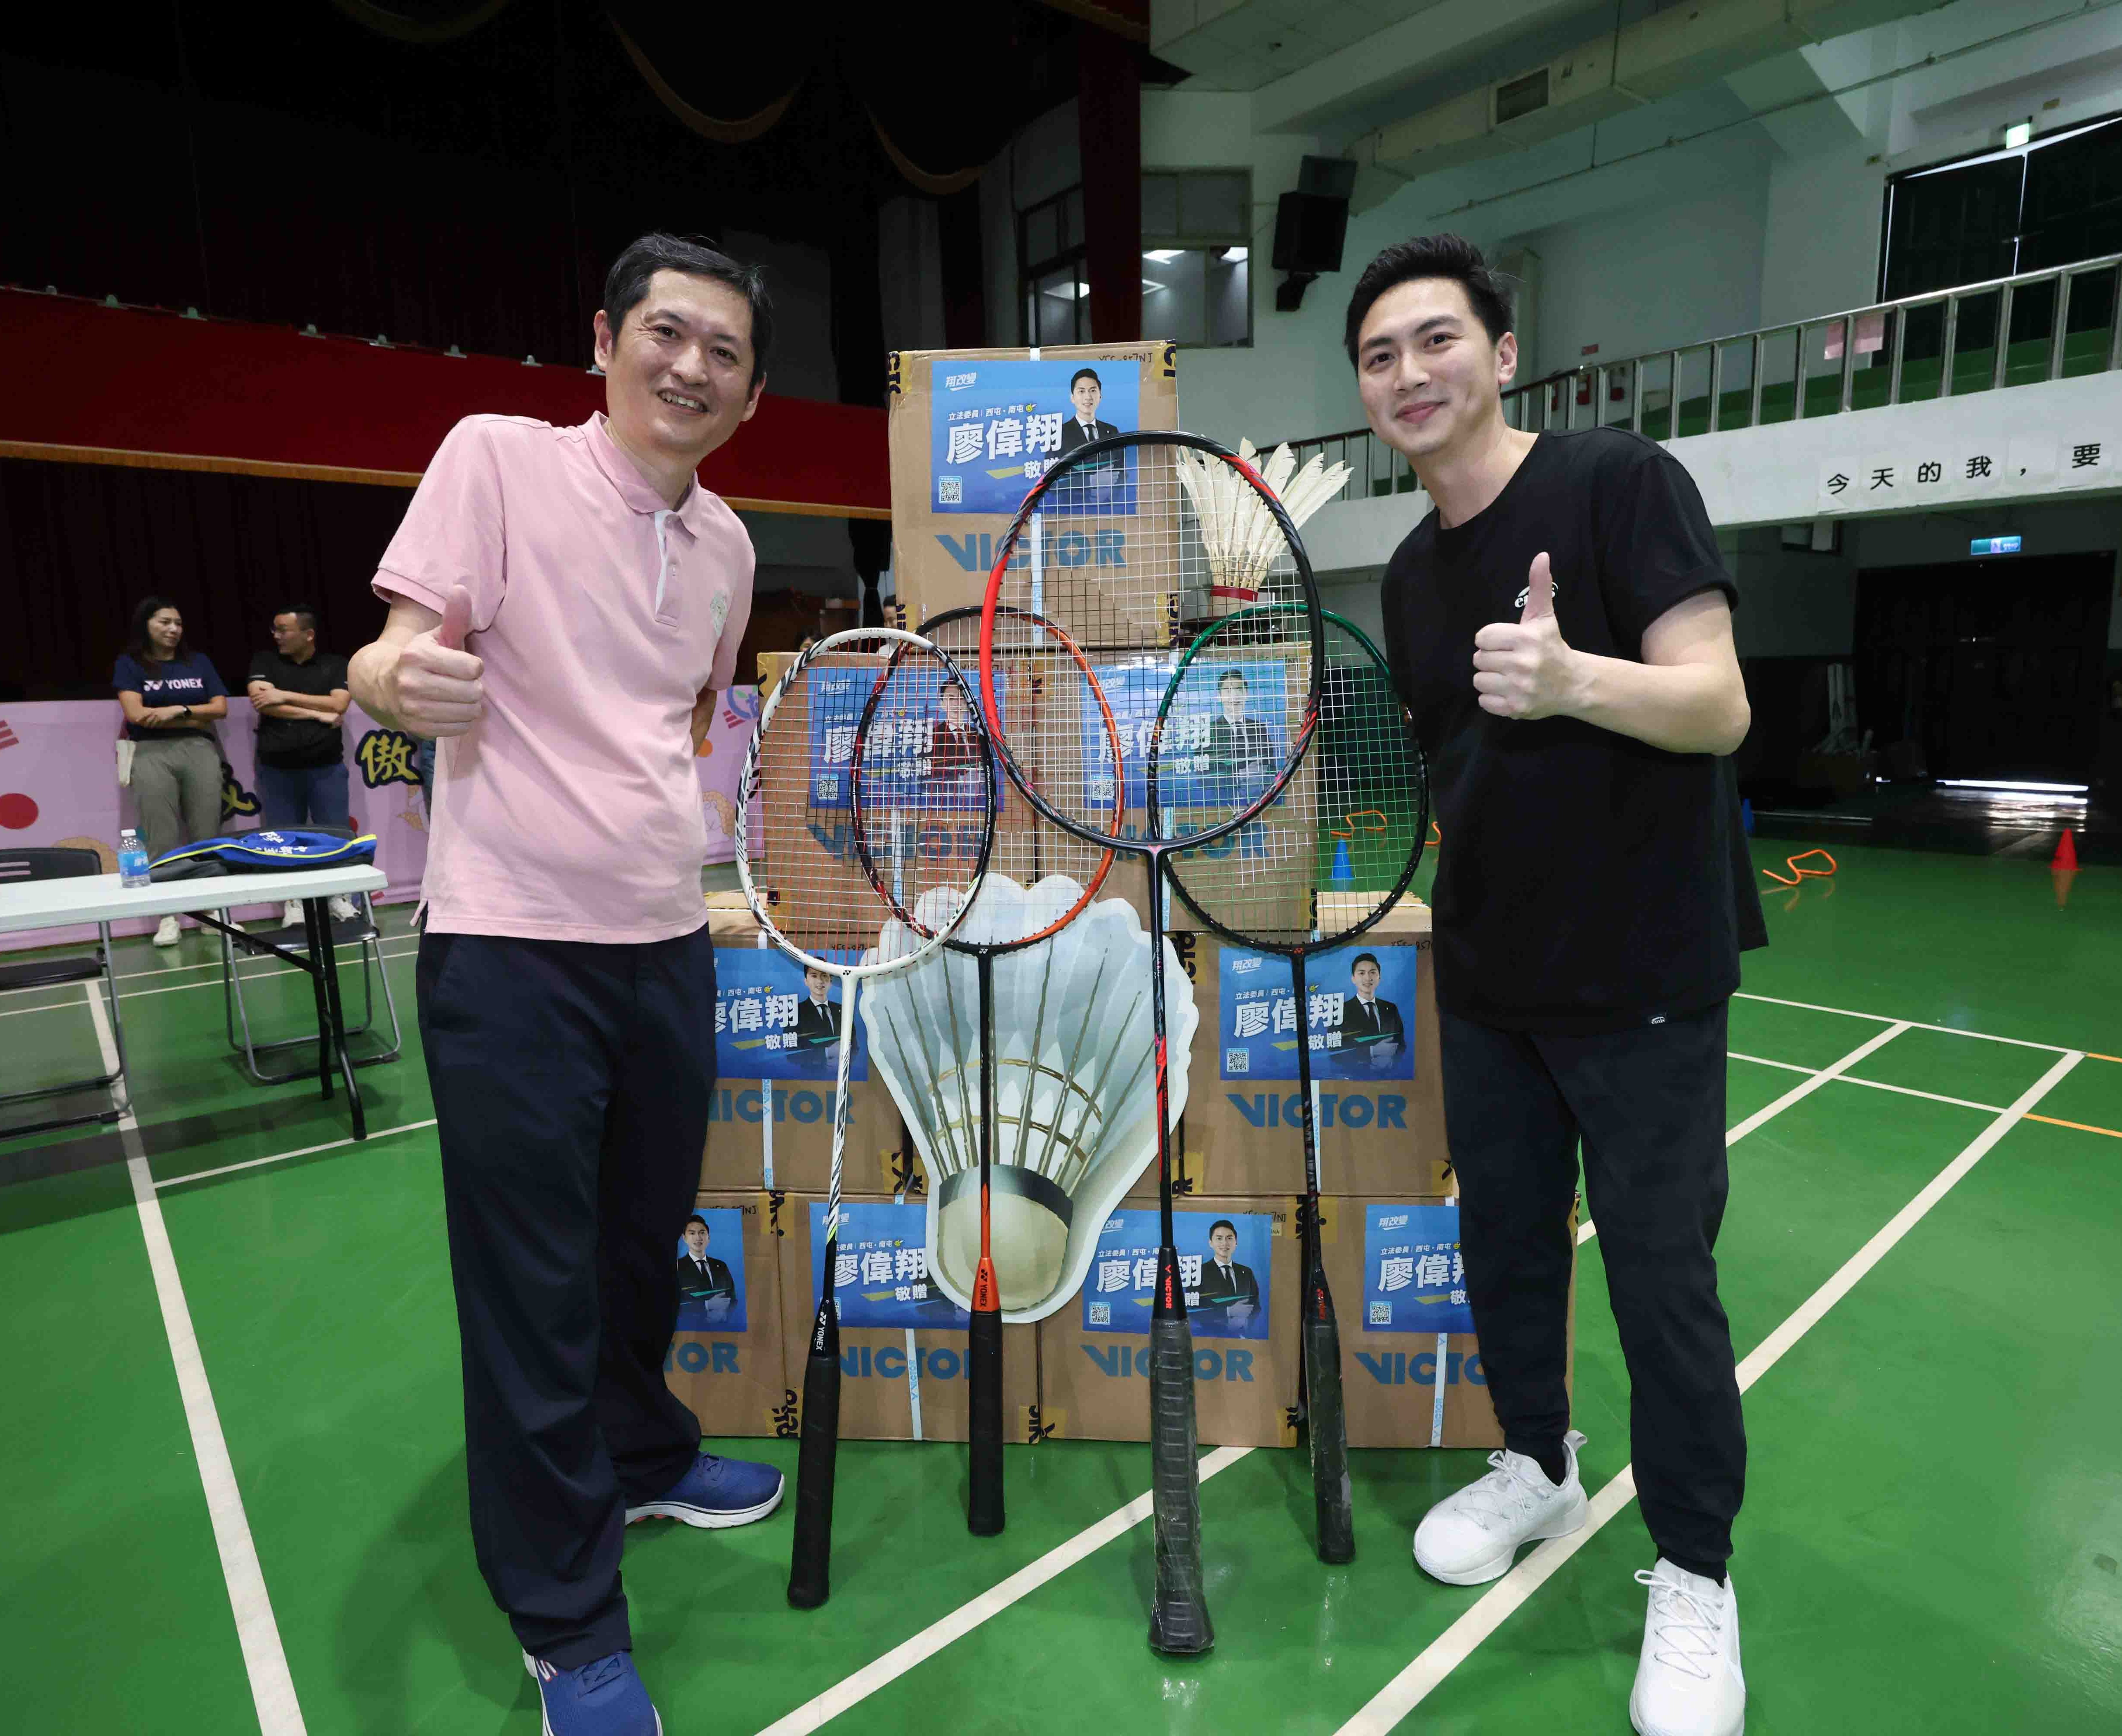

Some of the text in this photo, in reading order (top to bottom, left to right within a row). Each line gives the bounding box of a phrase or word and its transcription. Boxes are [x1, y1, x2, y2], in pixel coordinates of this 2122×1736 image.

[946, 372, 976, 388] 翔改變
[948, 409, 979, 421] 立法委員
[946, 413, 1063, 465] 廖偉翔
[933, 529, 1127, 572] VICTOR
[165, 678, 203, 689] YONEX
[897, 759, 931, 778] 敬贈
[1175, 754, 1209, 774] 敬贈
[1232, 957, 1262, 971] 翔改變
[1235, 990, 1264, 1000] 立法委員
[1234, 993, 1345, 1038] 廖偉翔
[764, 1032, 797, 1049] 敬贈
[1308, 1031, 1342, 1050] 敬贈
[1226, 1094, 1407, 1129] VICTOR
[1378, 1215, 1408, 1228] 翔改變
[1098, 1249, 1125, 1257] 立法委員
[1380, 1246, 1409, 1255] 立法委員
[834, 1248, 928, 1287] 廖偉翔
[895, 1283, 927, 1301] 敬贈
[816, 1327, 824, 1351] YONEX
[840, 1347, 969, 1380] VICTO
